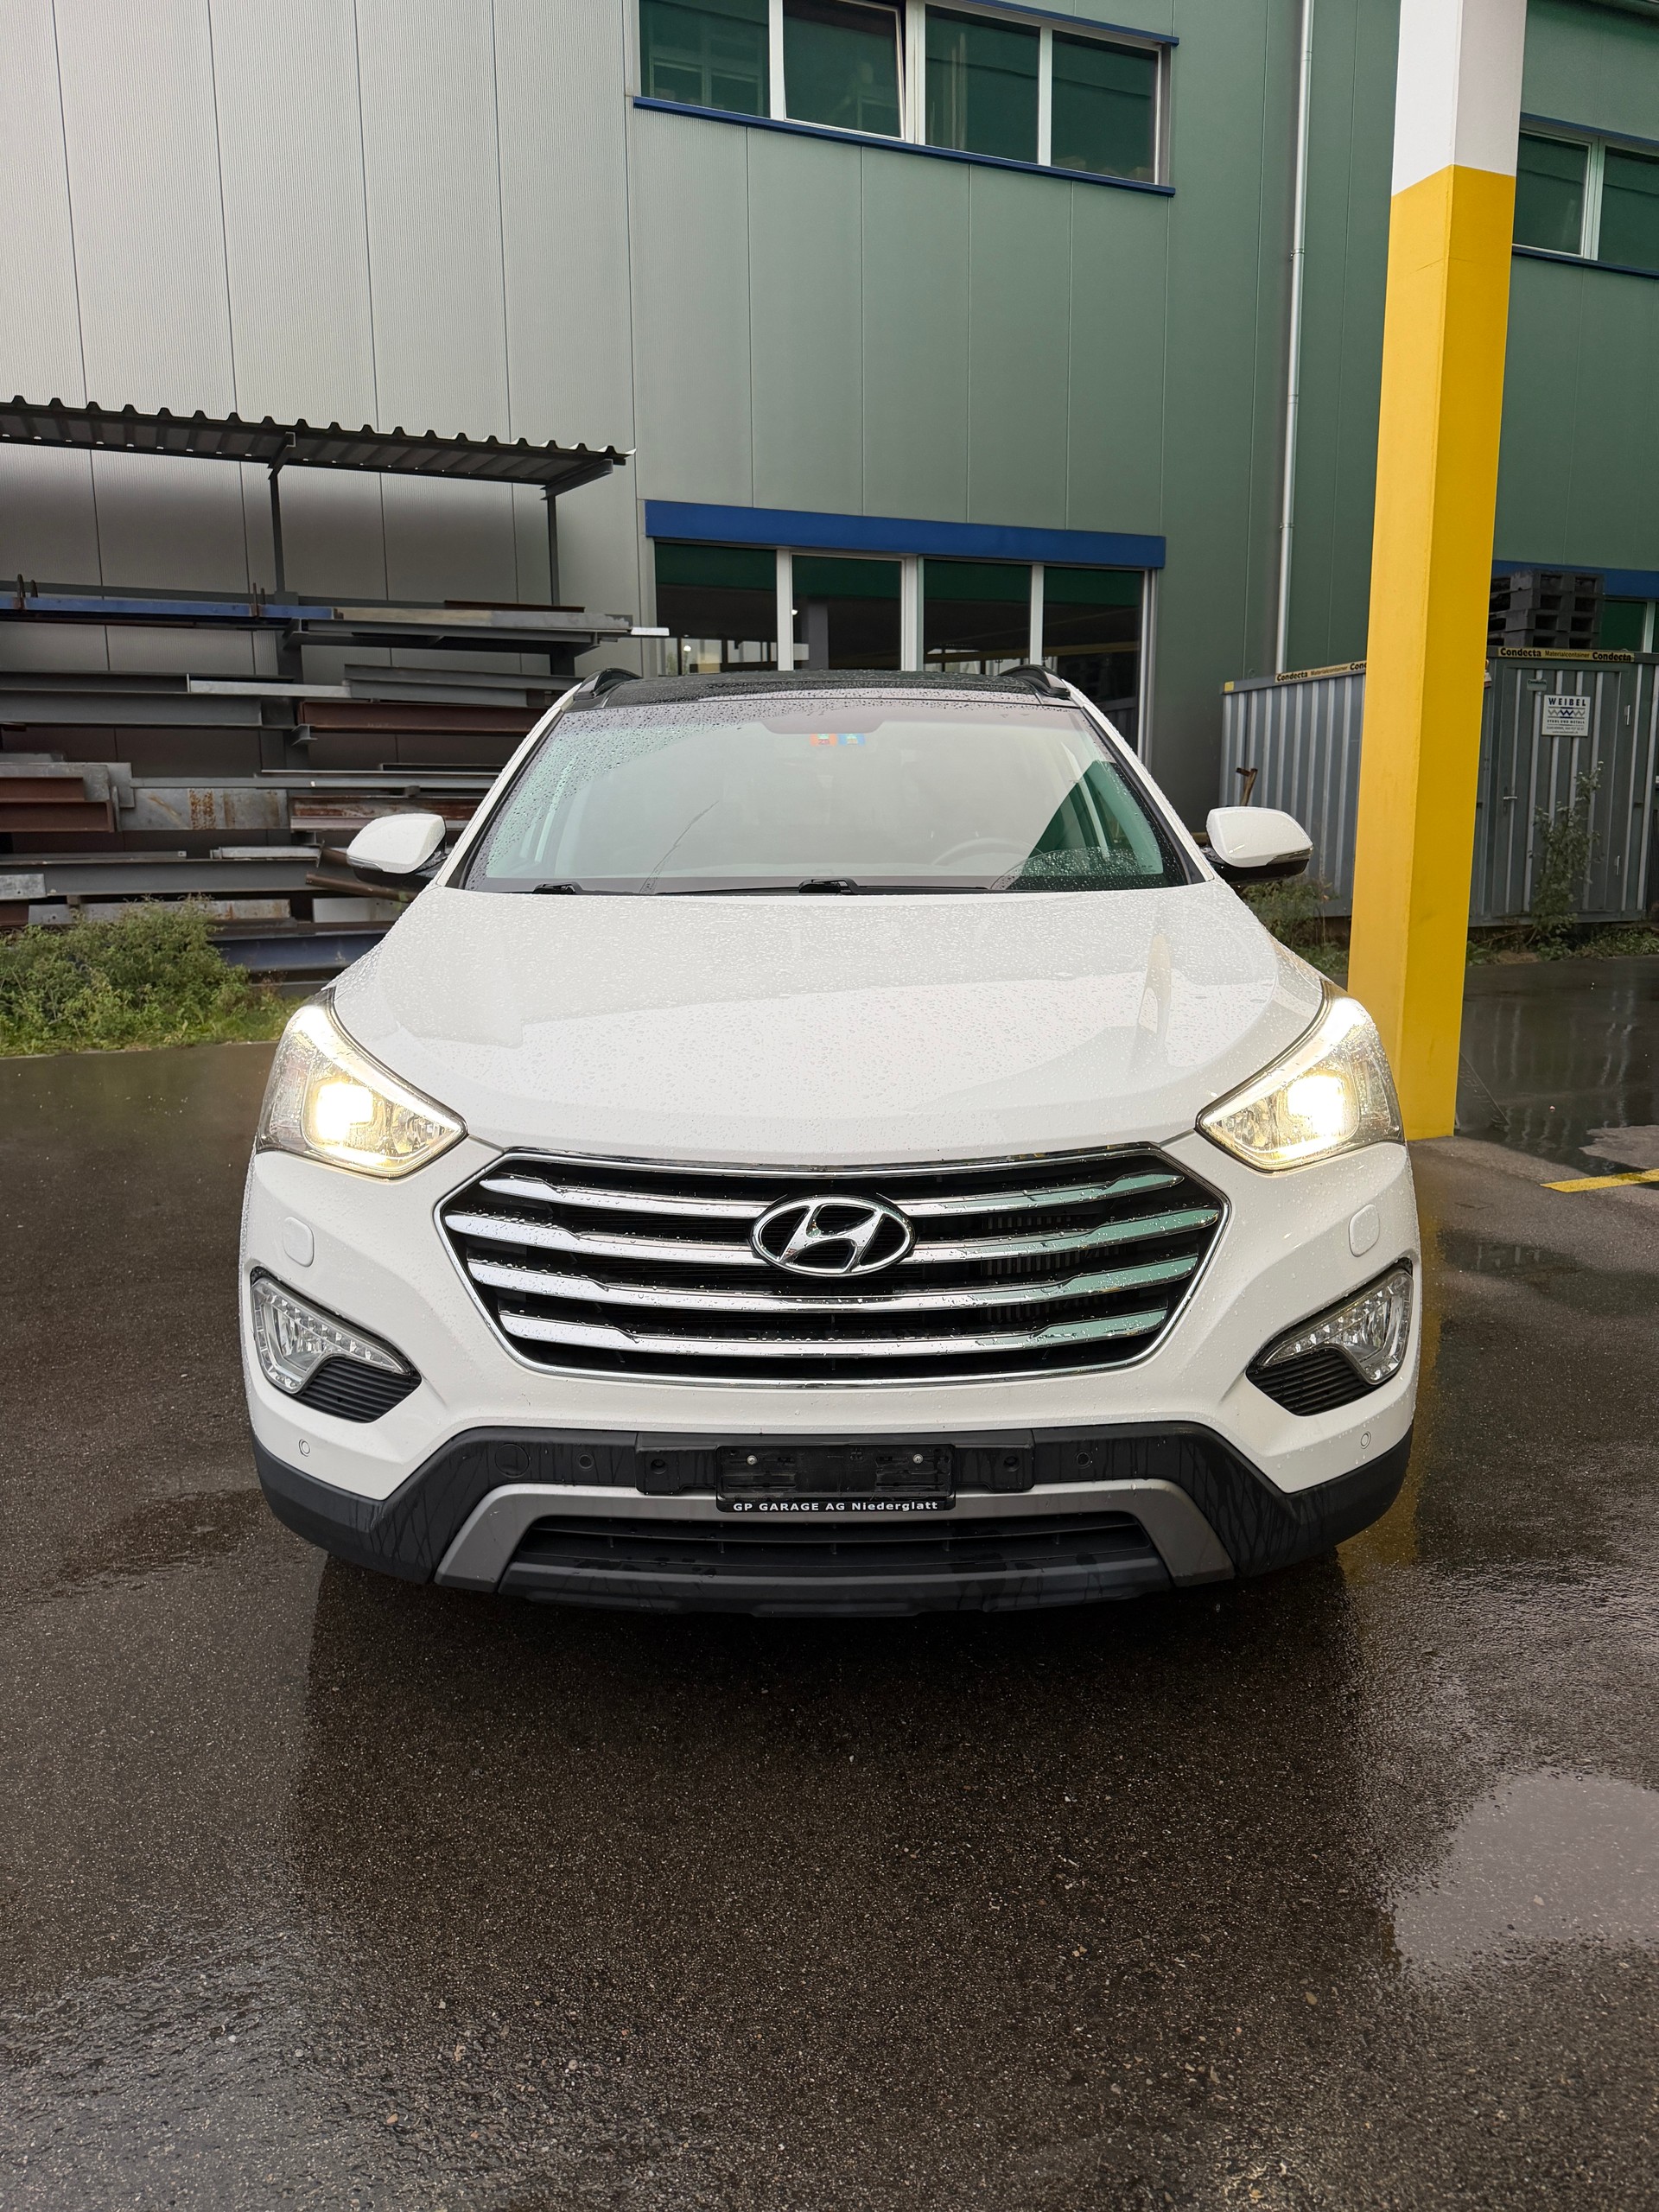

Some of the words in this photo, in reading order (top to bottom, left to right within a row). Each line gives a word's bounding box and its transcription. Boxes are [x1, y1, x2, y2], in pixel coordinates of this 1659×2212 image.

[1500, 647, 1541, 657] Condecta
[1592, 652, 1632, 661] Condecta
[1277, 671, 1307, 682] Condecta
[1548, 697, 1586, 707] WEIBEL
[733, 1503, 753, 1511] GP
[759, 1503, 819, 1511] GARAGE
[825, 1502, 845, 1511] AG
[852, 1501, 938, 1512] Niederglatt
